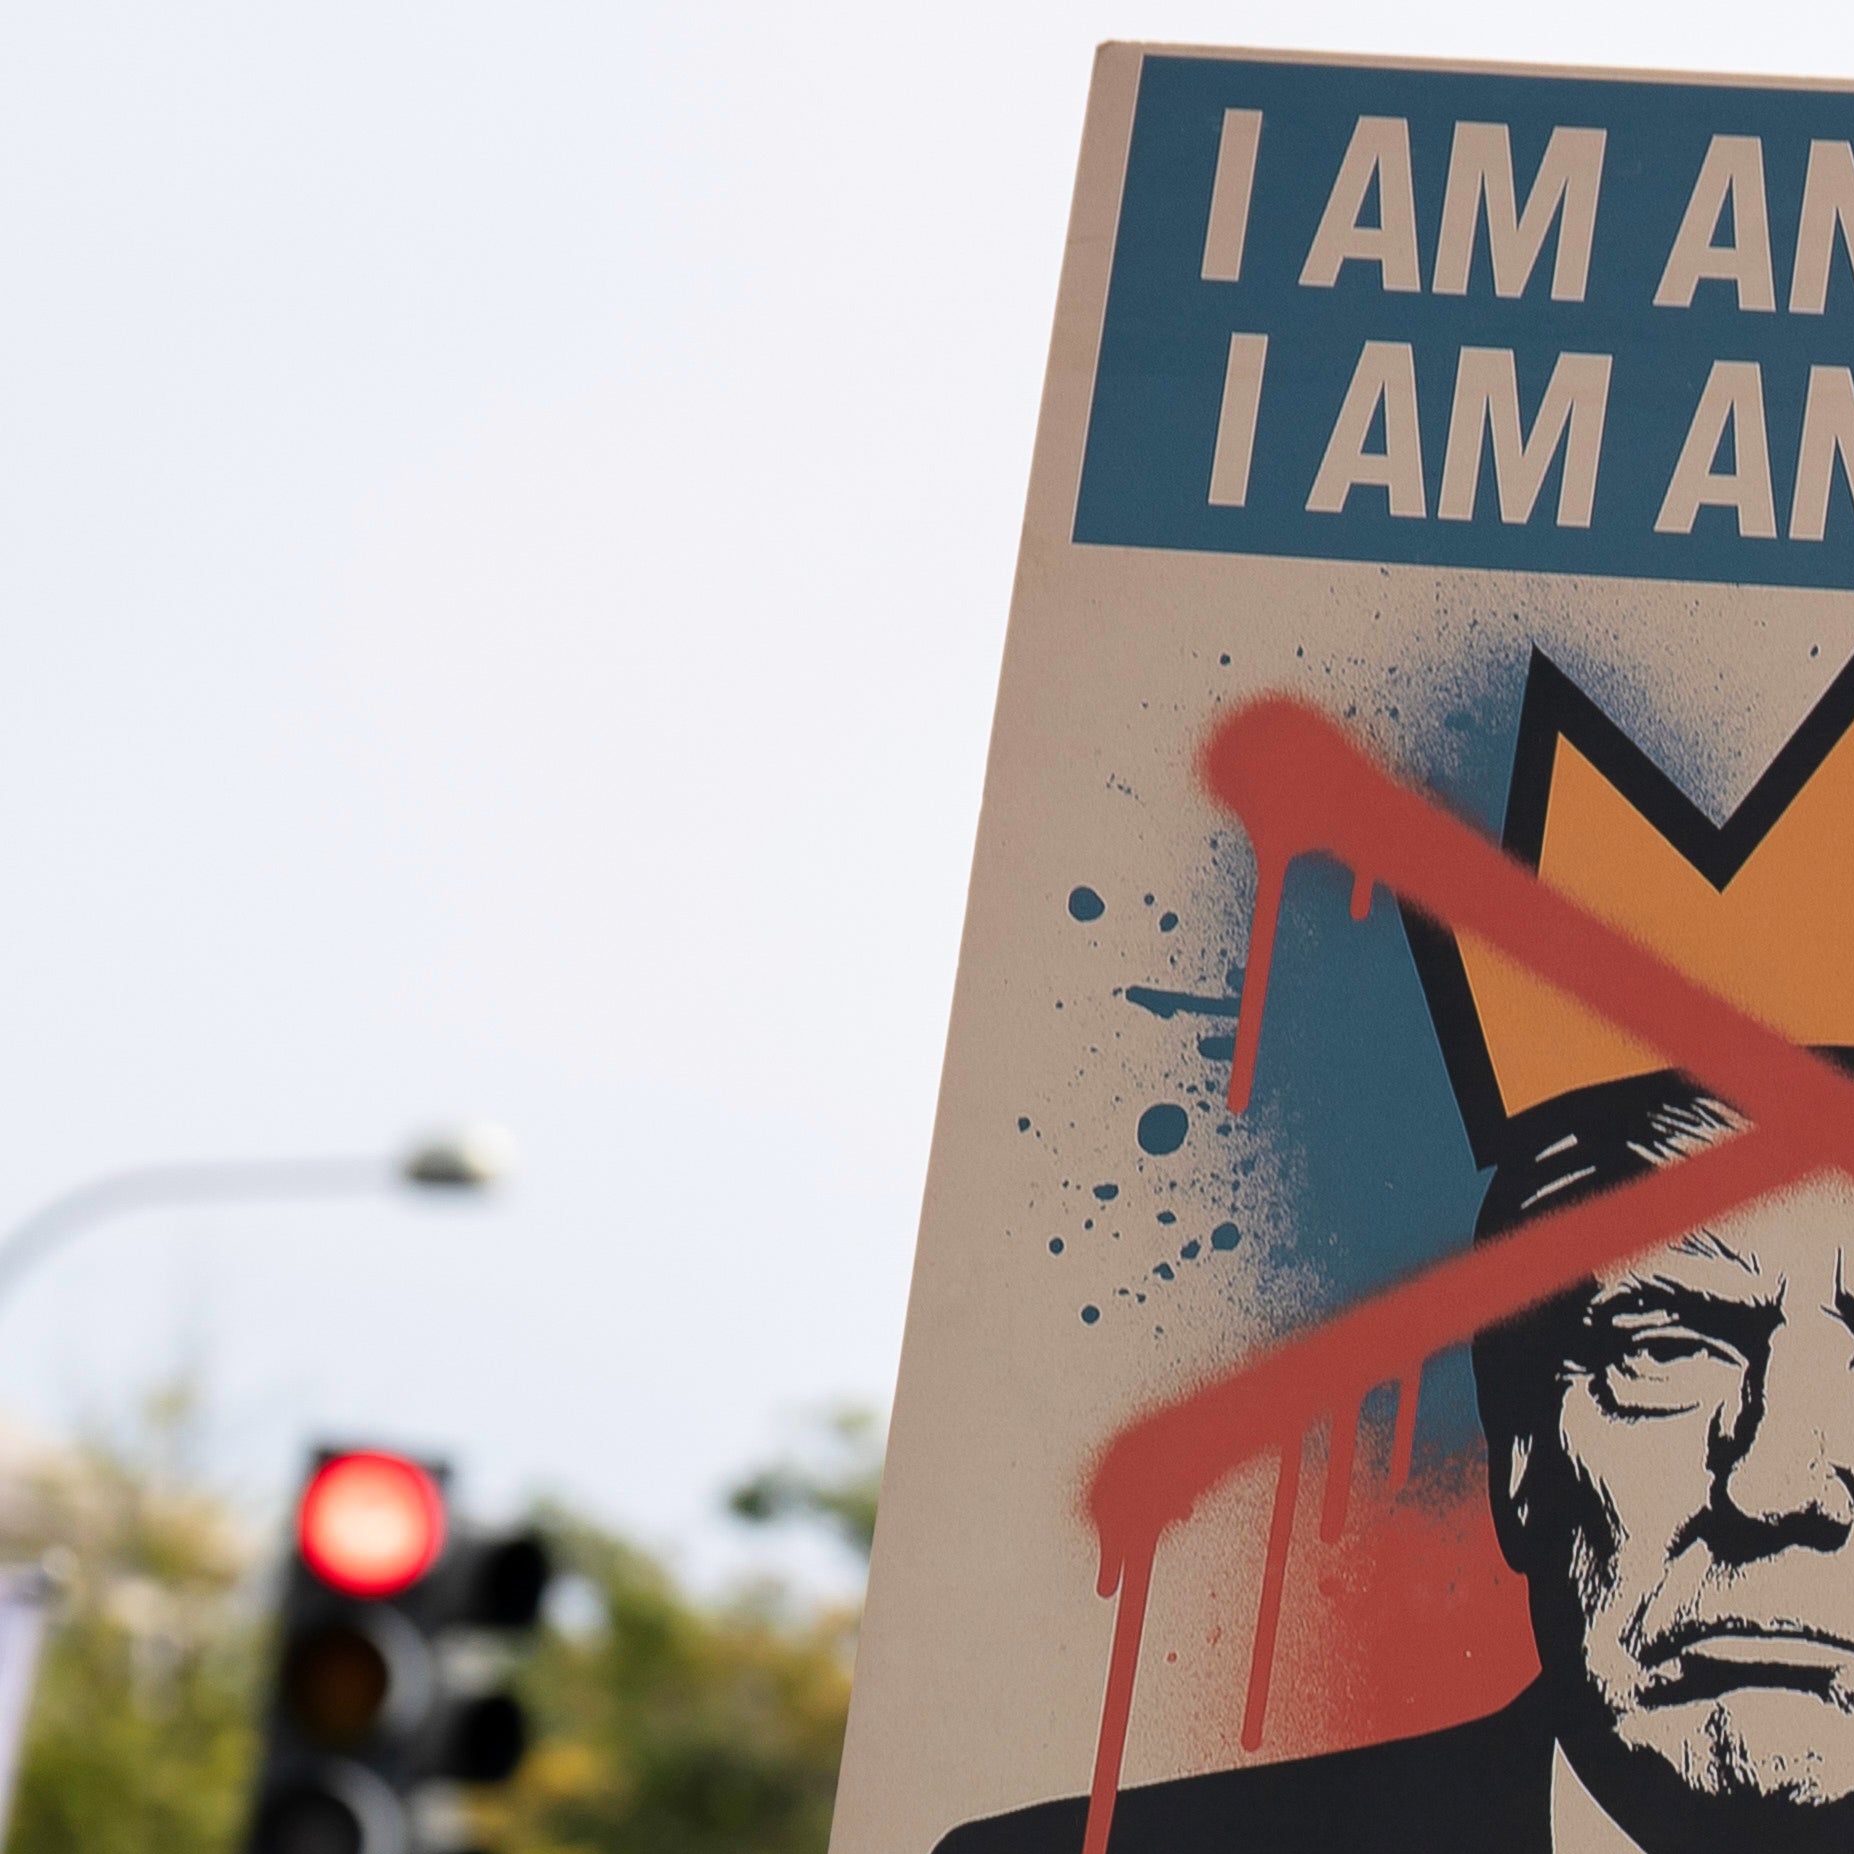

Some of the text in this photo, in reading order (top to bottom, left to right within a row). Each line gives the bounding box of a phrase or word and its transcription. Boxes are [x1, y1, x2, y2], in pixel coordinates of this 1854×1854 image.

[1200, 108, 1263, 281] I
[1300, 117, 1607, 301] AM
[1208, 334, 1269, 507] I
[1307, 343, 1613, 528] AM
